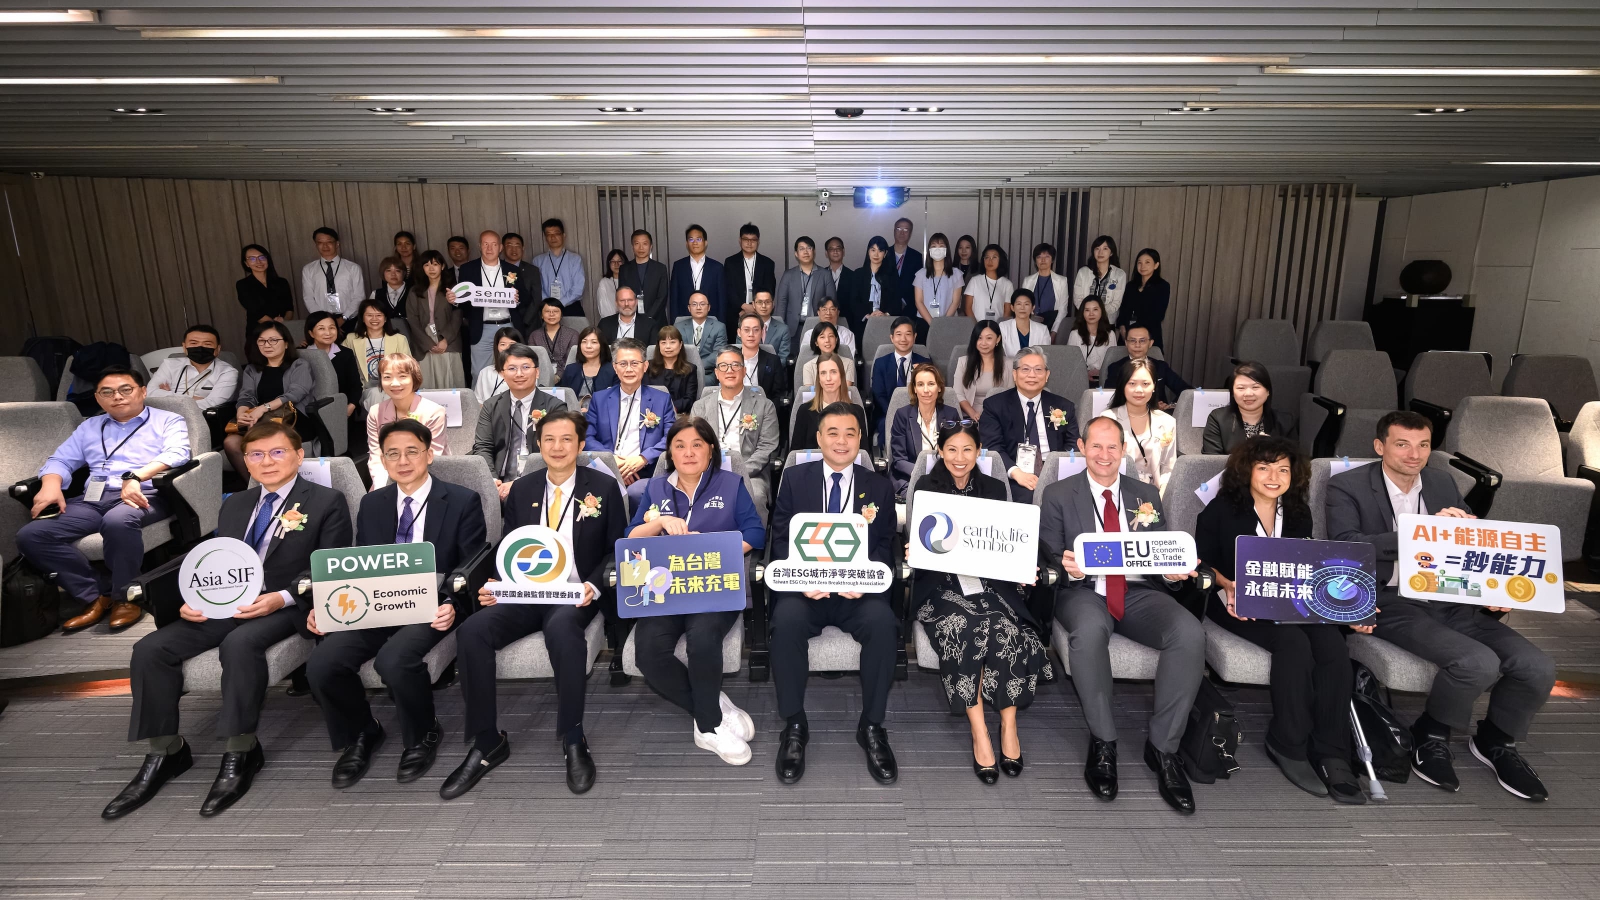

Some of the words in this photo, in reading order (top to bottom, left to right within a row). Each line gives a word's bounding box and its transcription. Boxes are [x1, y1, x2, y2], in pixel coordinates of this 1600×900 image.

[475, 290, 512, 298] semi
[963, 538, 1014, 554] symbio
[1412, 525, 1546, 552] AI+能源自主
[1124, 541, 1150, 558] EU
[327, 552, 410, 574] POWER
[668, 552, 722, 572] 為台灣
[1245, 560, 1314, 580] 金融賦能
[1445, 550, 1546, 579] =鈔能力
[188, 572, 222, 588] Asia
[228, 567, 254, 584] SIF
[670, 573, 740, 595] 未來充電
[773, 568, 885, 580] 台灣ESG城市淨零突破協會
[374, 586, 428, 599] Economic
[1245, 580, 1314, 600] 永續未來
[374, 600, 416, 612] Growth
